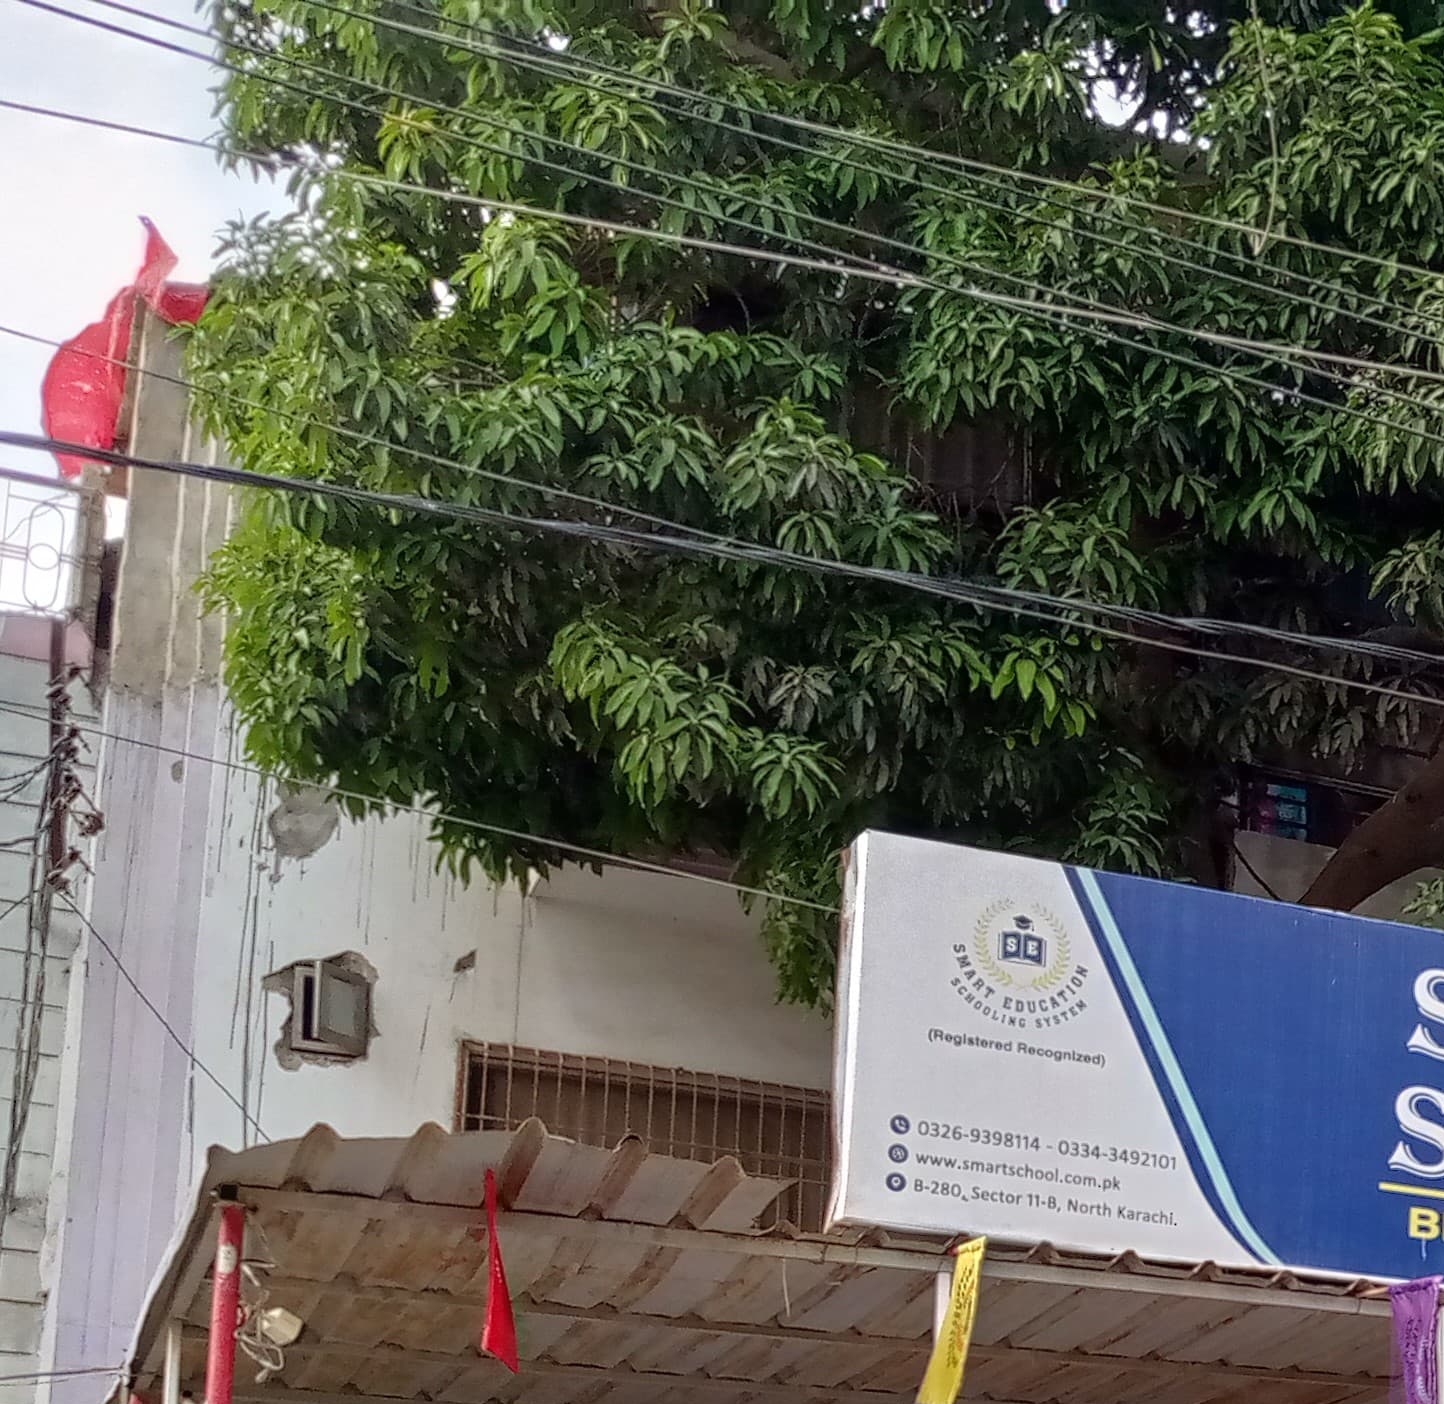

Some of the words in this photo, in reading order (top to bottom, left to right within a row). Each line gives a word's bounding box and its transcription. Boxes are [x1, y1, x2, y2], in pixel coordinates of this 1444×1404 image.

[953, 943, 996, 999] SMART
[1002, 964, 1089, 1014] EDUCATION
[950, 977, 1027, 1029] SCHOOLING
[1035, 999, 1088, 1029] SYSTEM
[928, 1027, 1013, 1052] (Registered
[1017, 1042, 1106, 1069] Recognized)
[918, 1120, 1041, 1152] 0326-9398114
[1058, 1140, 1177, 1171] 0334-3492101
[915, 1151, 1121, 1192] www.smartschool.com.pk
[970, 1186, 1023, 1206] Sector
[1027, 1193, 1062, 1213] 11-B,
[1067, 1199, 1112, 1218] North
[1117, 1205, 1178, 1227] Karachi.
